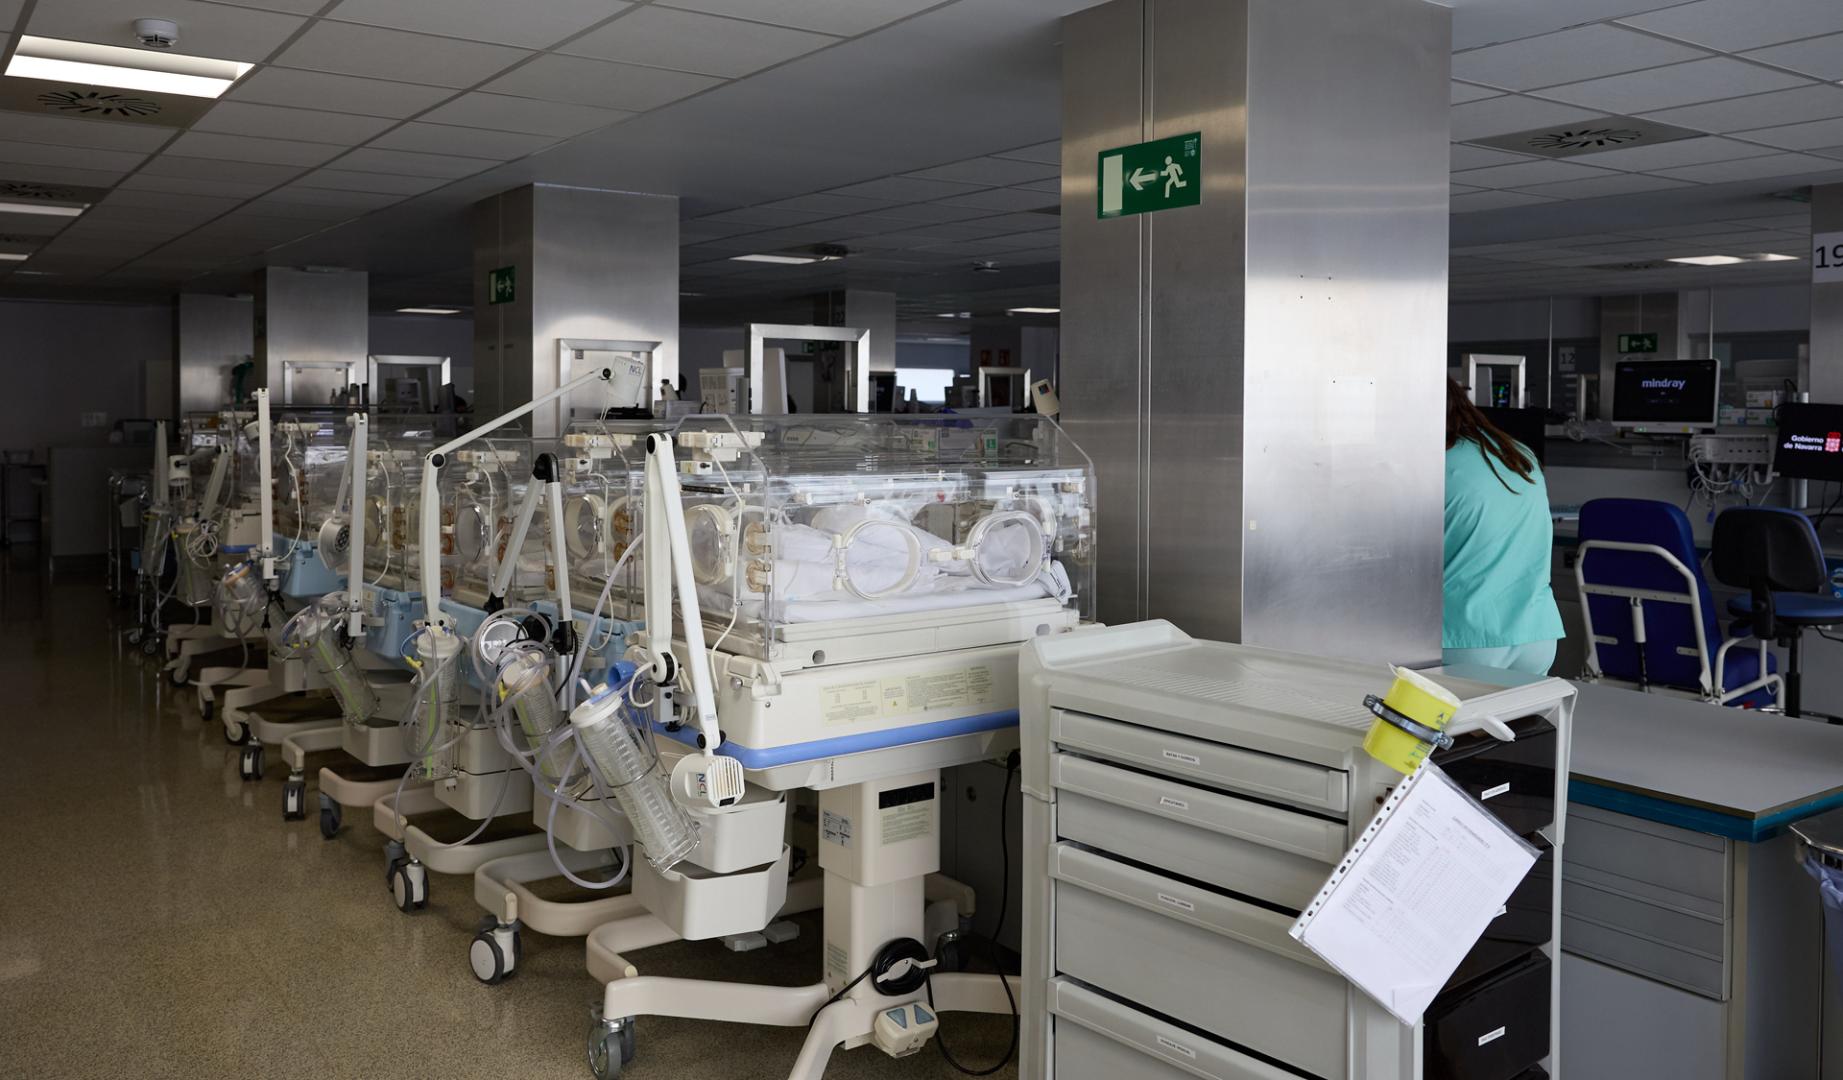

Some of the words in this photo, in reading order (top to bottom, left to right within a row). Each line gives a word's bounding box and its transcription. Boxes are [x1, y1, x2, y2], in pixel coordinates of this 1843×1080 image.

[1815, 244, 1843, 269] 19
[1561, 352, 1576, 364] 12
[1641, 378, 1686, 390] mindray
[1791, 434, 1824, 443] Gobierno
[1794, 442, 1823, 451] Navarra
[697, 773, 707, 796] NCL
